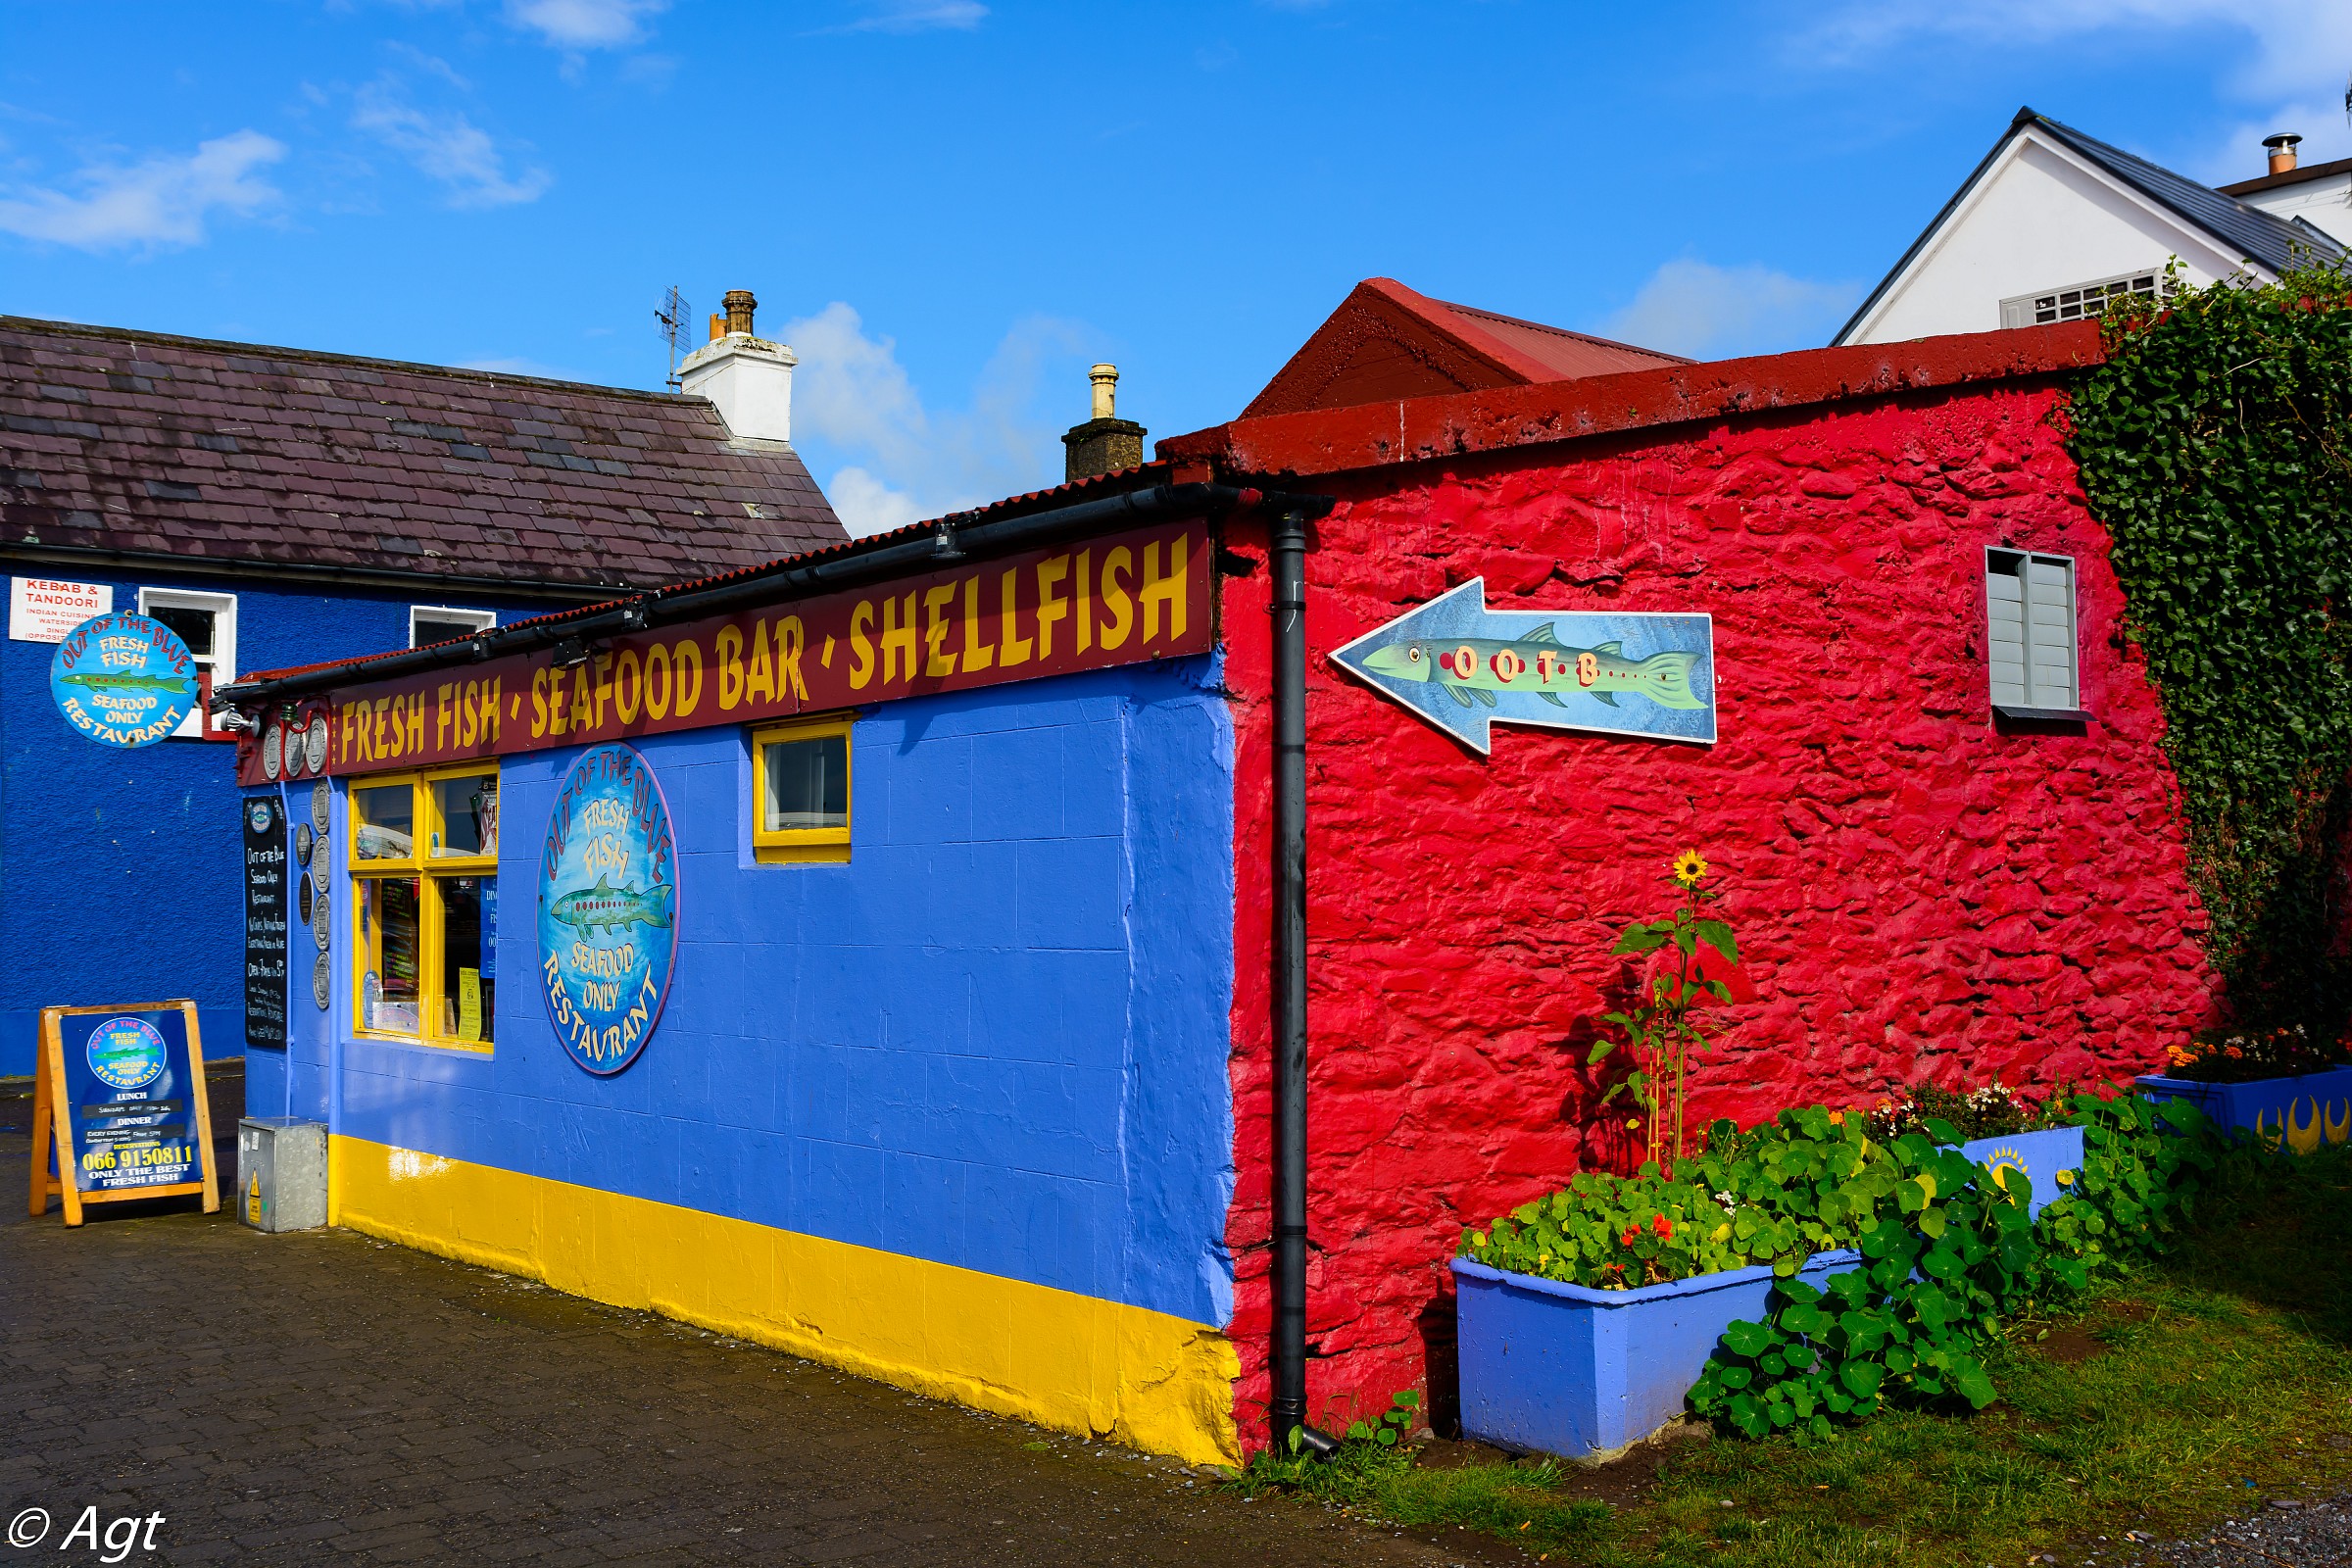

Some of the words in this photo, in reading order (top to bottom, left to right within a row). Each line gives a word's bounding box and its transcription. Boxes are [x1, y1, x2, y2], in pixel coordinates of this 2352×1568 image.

[26, 580, 81, 593] KEBAB
[88, 586, 97, 595] &
[25, 593, 98, 608] TANDOORI
[62, 629, 88, 669] OUT
[91, 618, 113, 634] OF
[118, 617, 151, 634] THE
[153, 626, 192, 674] BLUE
[99, 636, 149, 653] FRESH
[341, 689, 425, 764] FRESH
[436, 675, 501, 752] FISH
[530, 638, 703, 739] SEAFOOD
[715, 615, 809, 710] BAR
[849, 532, 1188, 690] SHELLFISH
[101, 651, 147, 668] FISH
[92, 694, 158, 710] SEAFOOD
[63, 698, 181, 744] RESTAURANT
[106, 711, 144, 724] ONLY
[547, 790, 572, 881] OUT
[575, 764, 596, 796] OF
[601, 751, 633, 786] THE
[632, 766, 672, 884] BLUE
[584, 798, 629, 836] FRESH
[584, 832, 629, 880] FISH
[572, 941, 634, 977] SEAFOOD
[544, 951, 657, 1062] RESTAURANT
[583, 980, 620, 1011] ONLY
[91, 1030, 105, 1050] OUT
[105, 1022, 116, 1032] OF
[120, 1020, 139, 1029] THE
[140, 1025, 161, 1045] BLUE
[96, 1062, 160, 1085] RESTAURANT
[117, 1092, 148, 1101] LUNCH
[118, 1116, 152, 1126] DINNER
[114, 1141, 161, 1150] RESERVATIONS
[82, 1152, 117, 1171] 066
[120, 1146, 192, 1167] 9150811
[88, 1169, 123, 1179] ONLY
[125, 1166, 153, 1176] THE
[156, 1164, 190, 1174] BEST
[103, 1176, 145, 1187] FRESH
[149, 1174, 178, 1183] FISH
